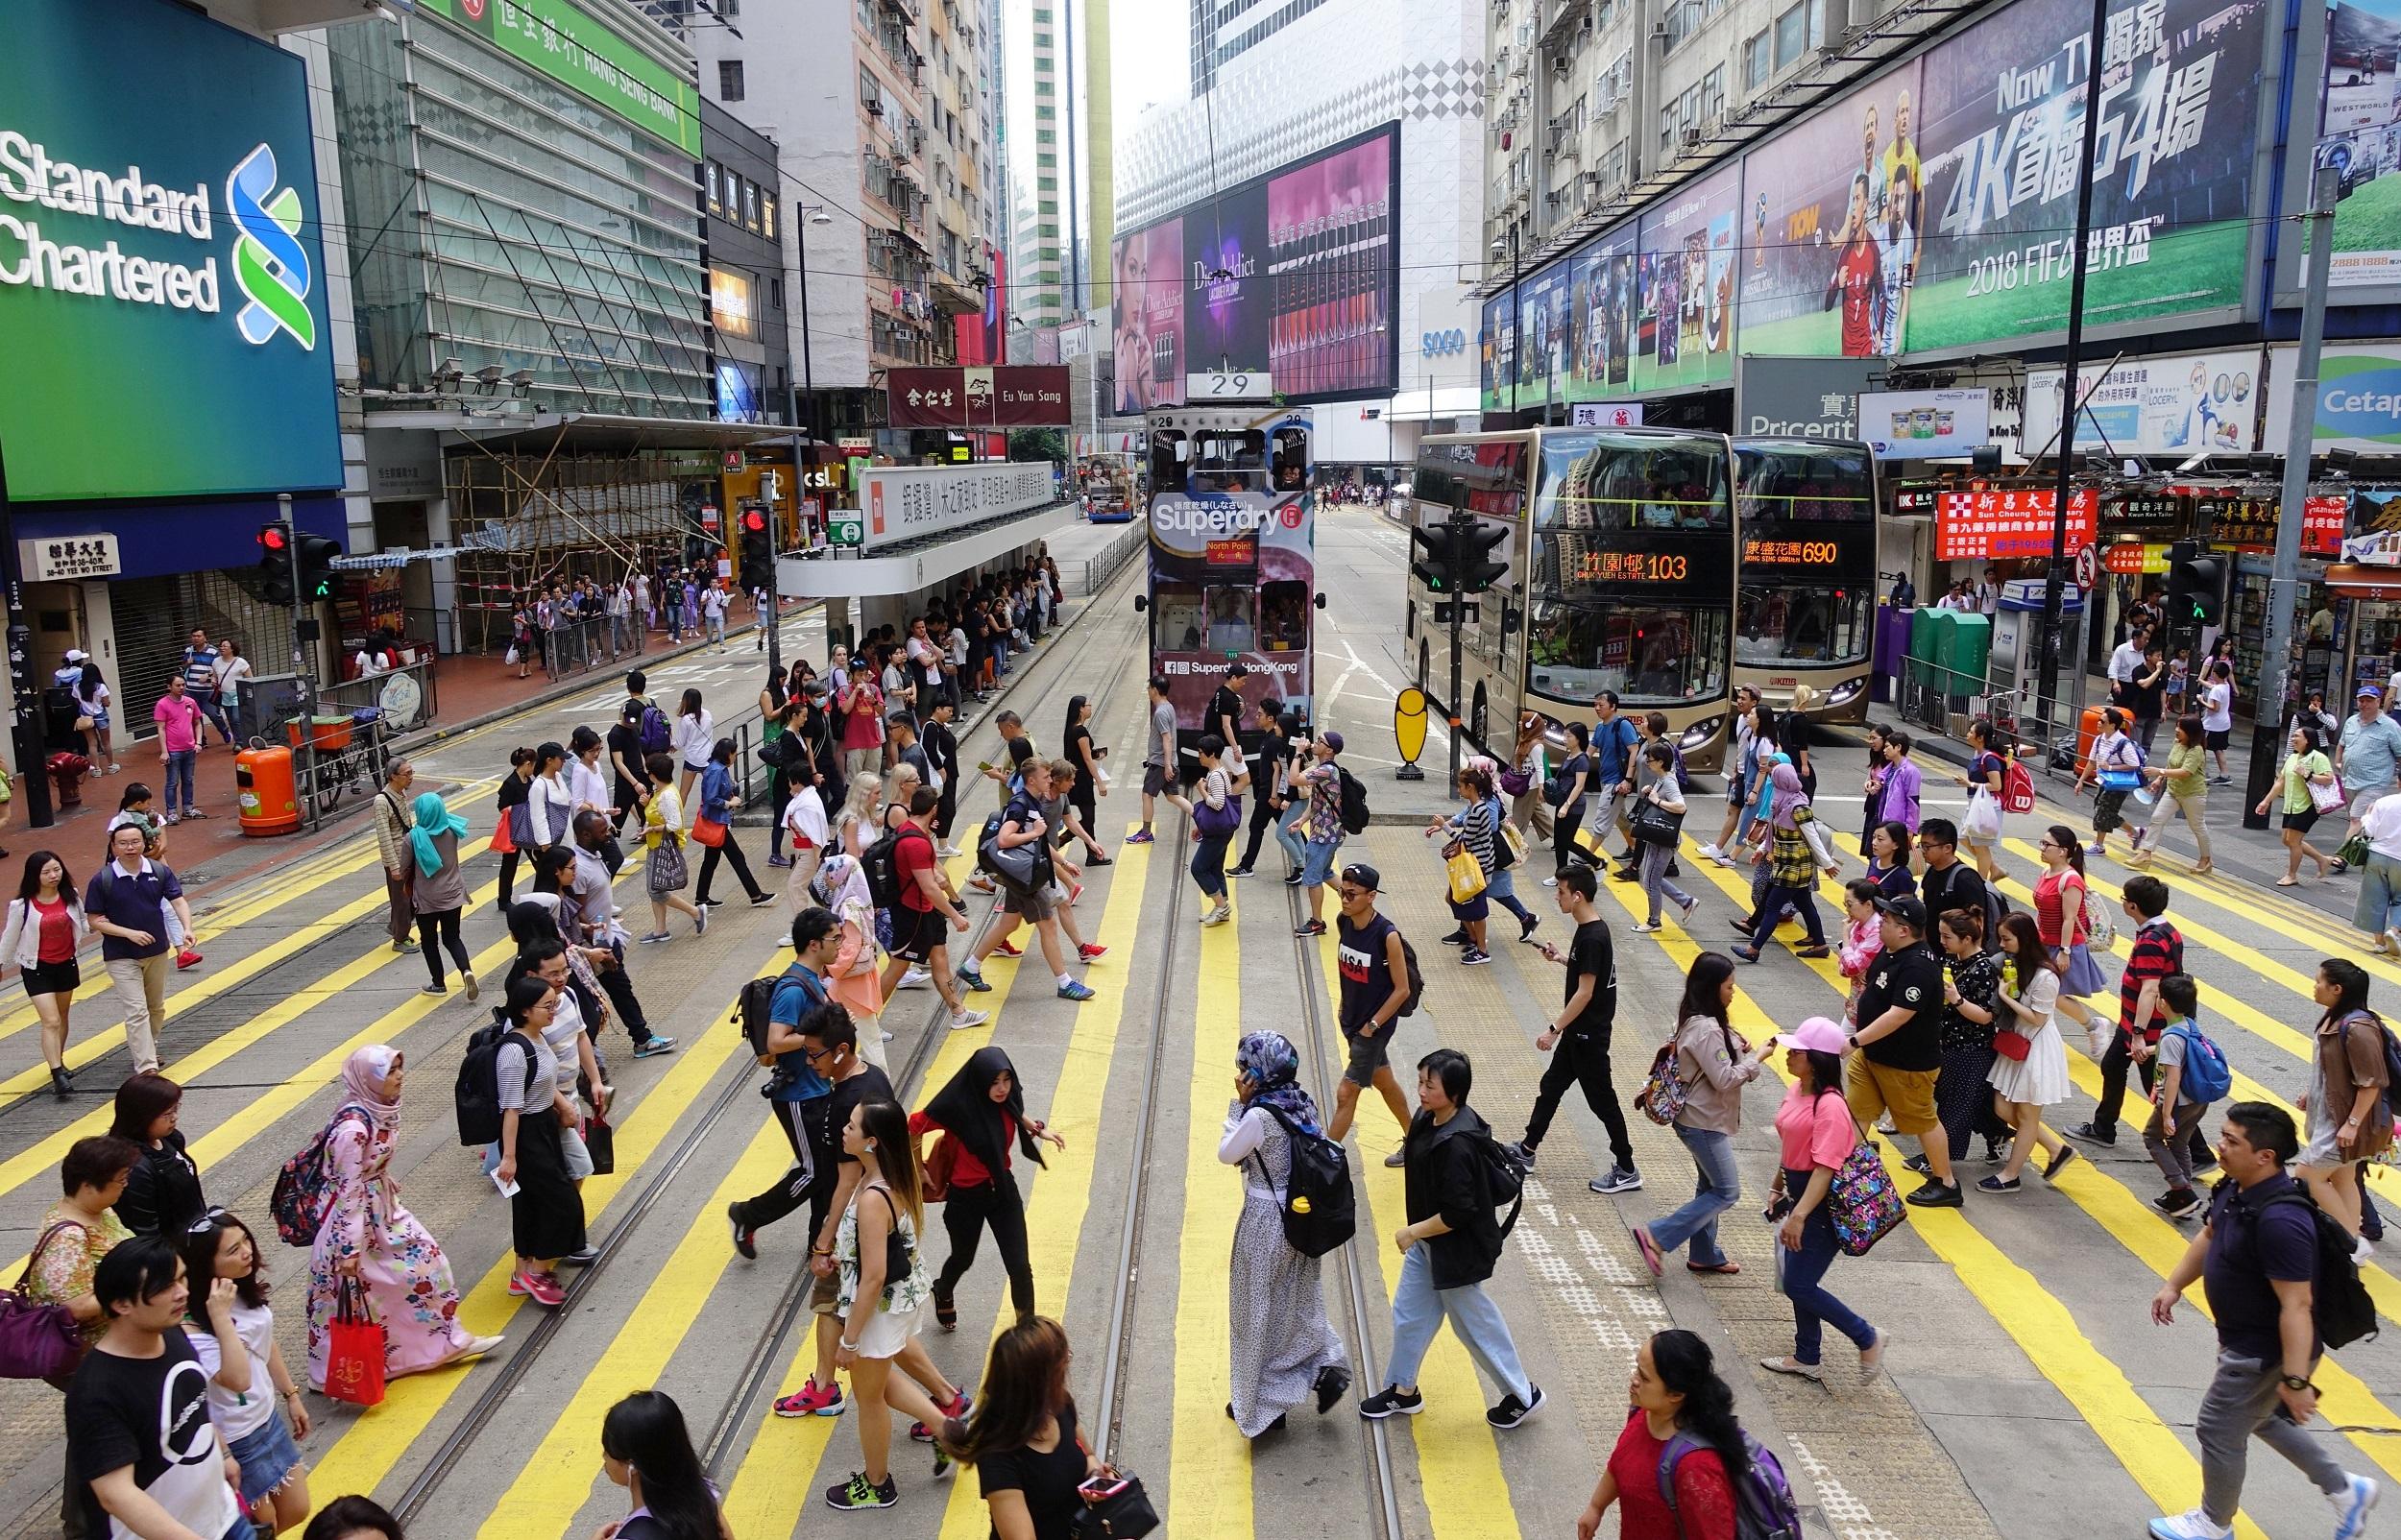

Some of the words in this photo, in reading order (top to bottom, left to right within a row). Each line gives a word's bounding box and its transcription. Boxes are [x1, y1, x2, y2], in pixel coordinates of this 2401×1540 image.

[584, 45, 617, 87] HANG
[619, 67, 648, 107] SENG
[650, 86, 678, 125] BANK
[1997, 60, 2056, 114] Now
[2333, 102, 2389, 113] WESTWORLD
[0, 131, 212, 240] Standard
[0, 214, 221, 313] Chartered
[2331, 258, 2360, 268] 2888
[2362, 256, 2389, 266] 1888
[1966, 250, 2019, 298] 2018
[1423, 328, 1465, 359] SOGO
[1211, 374, 1249, 396] 29
[907, 388, 954, 408] 余仁生
[1003, 390, 1014, 402] Eu
[1017, 391, 1034, 402] Yan
[1038, 389, 1061, 403] Sang
[2148, 395, 2178, 406] LOCERYL
[1158, 417, 1174, 428] 29
[1286, 415, 1301, 426] 29
[1578, 409, 1596, 425] 德
[1998, 510, 2031, 519] Cheung
[2038, 509, 2085, 518] Dispsary
[2129, 501, 2174, 512] 觀奇洋服
[1156, 503, 1281, 537] Superdry
[1207, 541, 1229, 550] North
[1231, 541, 1251, 550] Point
[1745, 541, 1802, 556] 康盛花園
[1803, 541, 1837, 564] 690
[1217, 551, 1243, 560] 北角
[1583, 550, 1644, 573] 竹園邨
[67, 566, 78, 575] YEE
[92, 564, 113, 573] STREET
[1648, 554, 1687, 581] 103
[1597, 571, 1616, 580] YUEN
[1617, 571, 1646, 580] ESTATE
[1191, 662, 1298, 674] SuperdHongKong
[1777, 677, 1797, 686] KMB
[1341, 950, 1364, 975] USA
